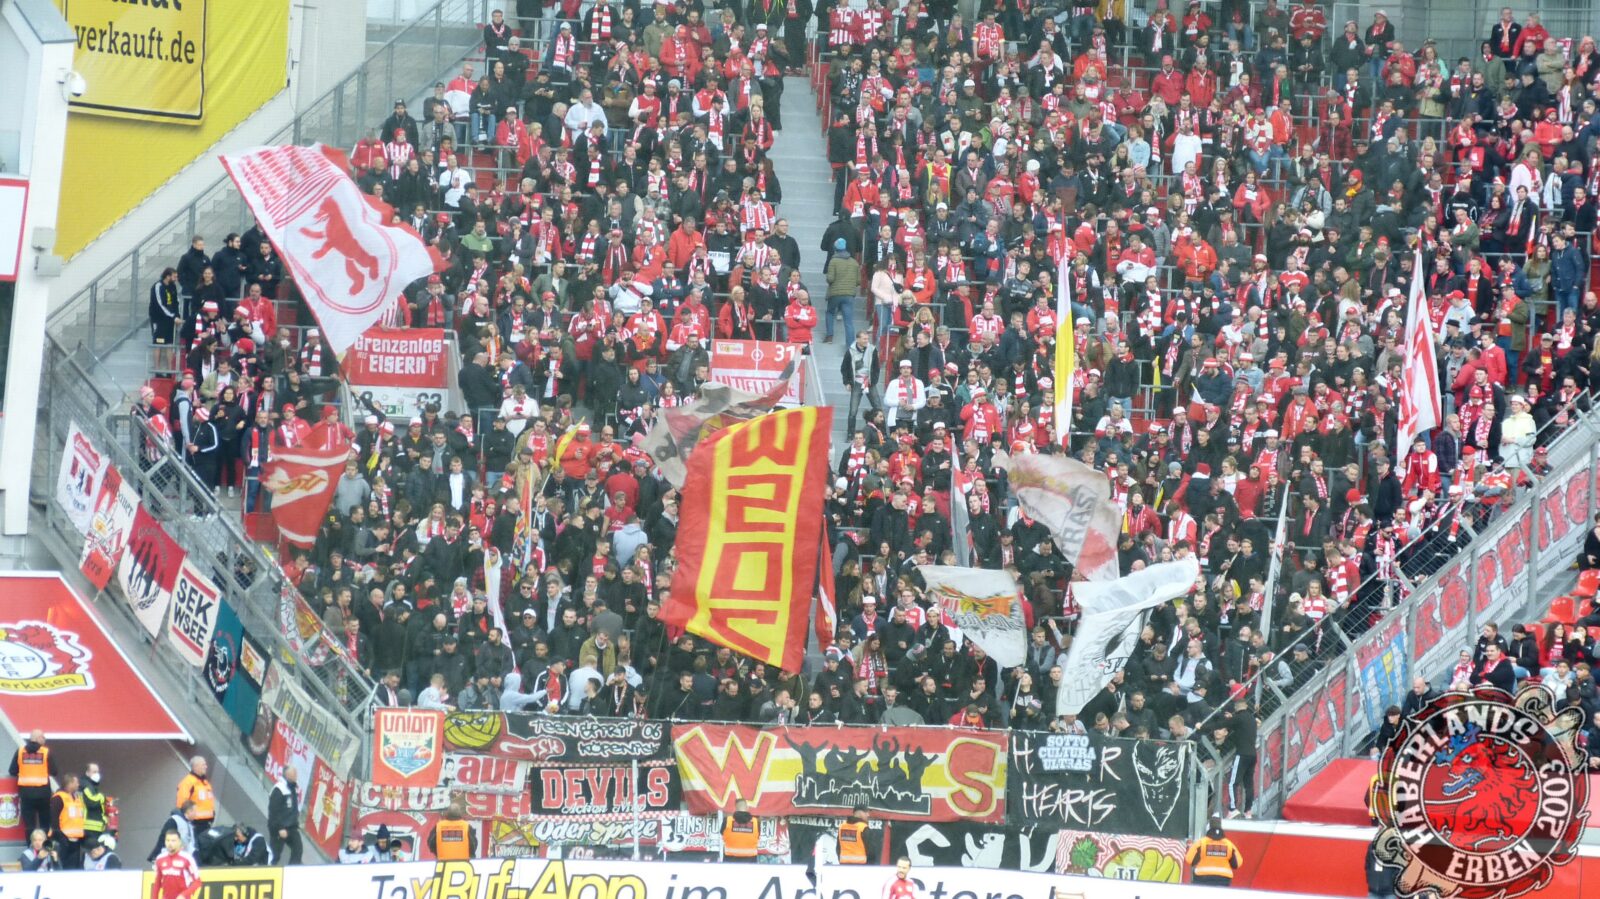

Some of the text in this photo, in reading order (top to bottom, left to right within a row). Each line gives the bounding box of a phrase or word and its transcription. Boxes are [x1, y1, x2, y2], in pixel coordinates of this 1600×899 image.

[75, 21, 196, 64] verkauft.de
[354, 335, 442, 354] Grenzenlos
[177, 578, 213, 627] SEK
[174, 604, 207, 649] WSEE
[383, 714, 436, 733] UNION
[1046, 735, 1090, 747] SOTTO
[675, 726, 1002, 817] W S
[1038, 746, 1096, 760] CULTURA
[1042, 758, 1093, 771] ULTRAS
[540, 767, 671, 809] DEVILS
[1022, 782, 1117, 828] HEARTS
